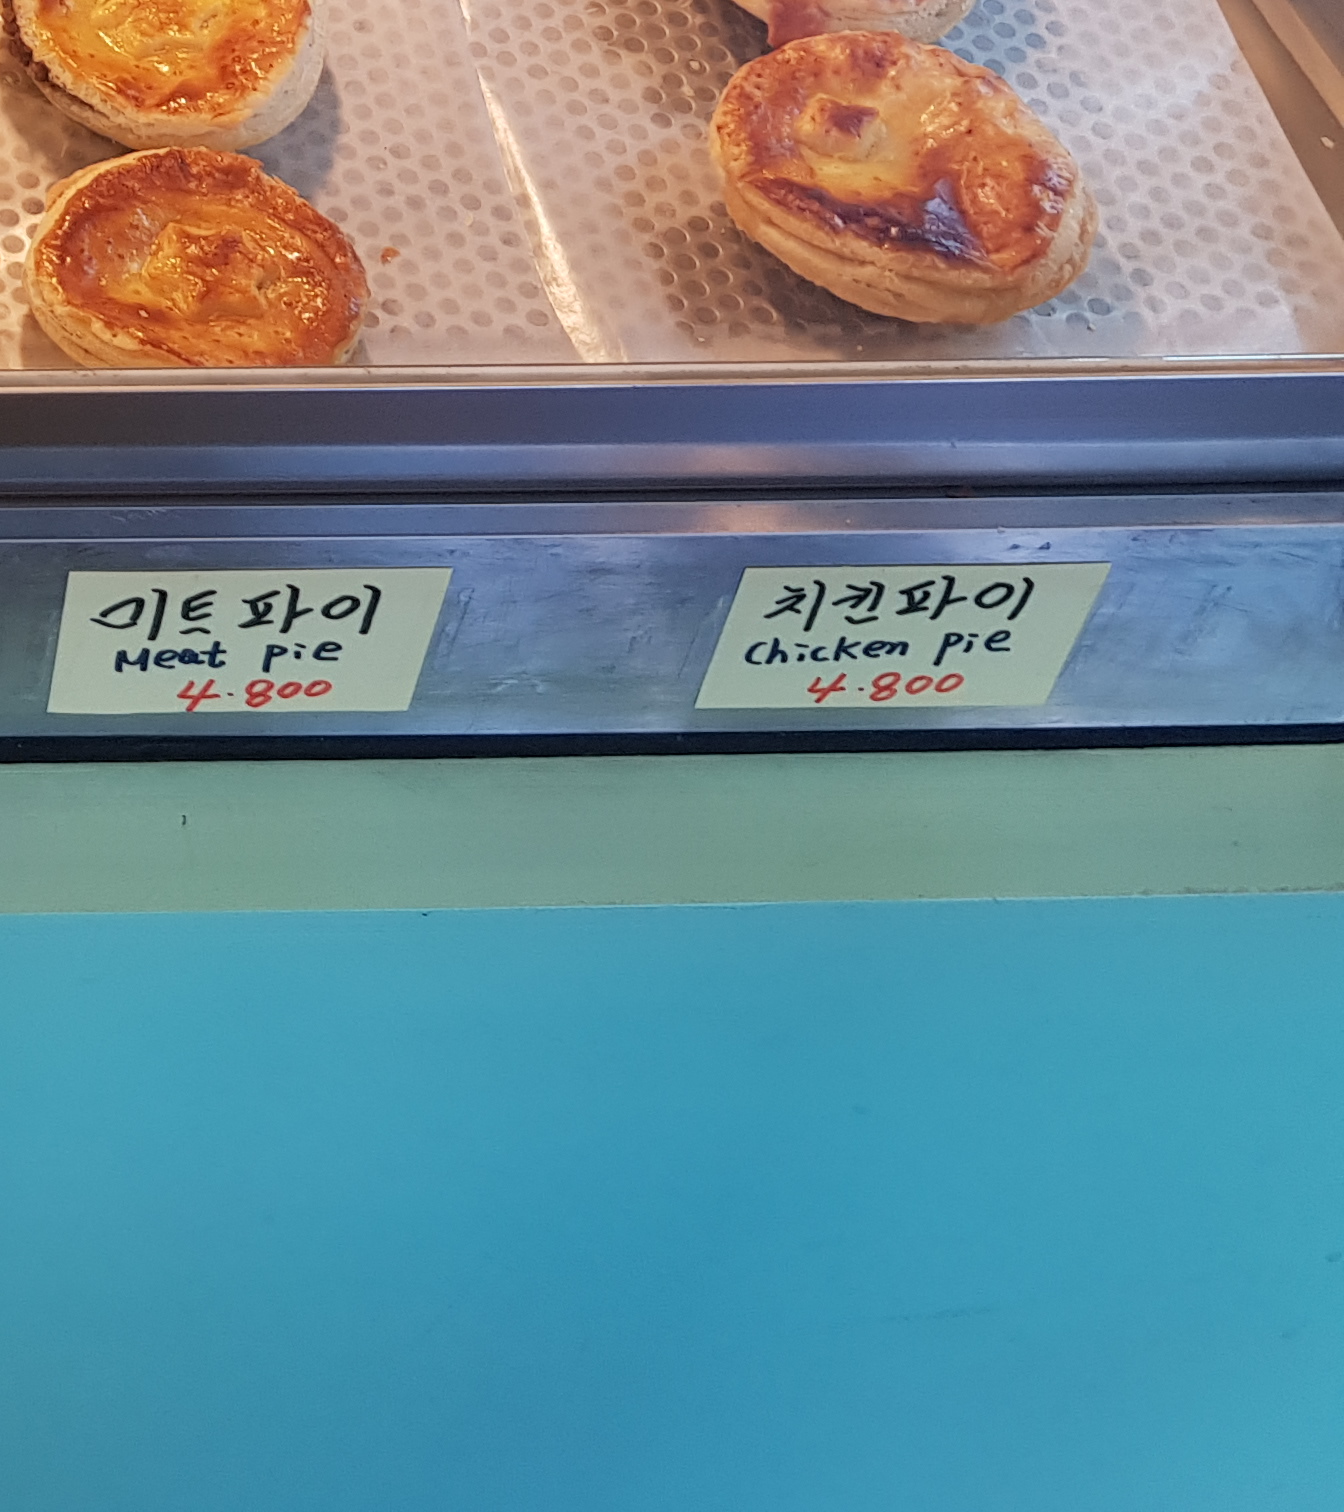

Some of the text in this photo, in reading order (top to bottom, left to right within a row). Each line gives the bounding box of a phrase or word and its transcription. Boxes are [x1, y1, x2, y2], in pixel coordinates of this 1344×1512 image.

[114, 640, 227, 674] Meat
[177, 678, 333, 712] 4.800
[806, 671, 965, 704] 4.800
